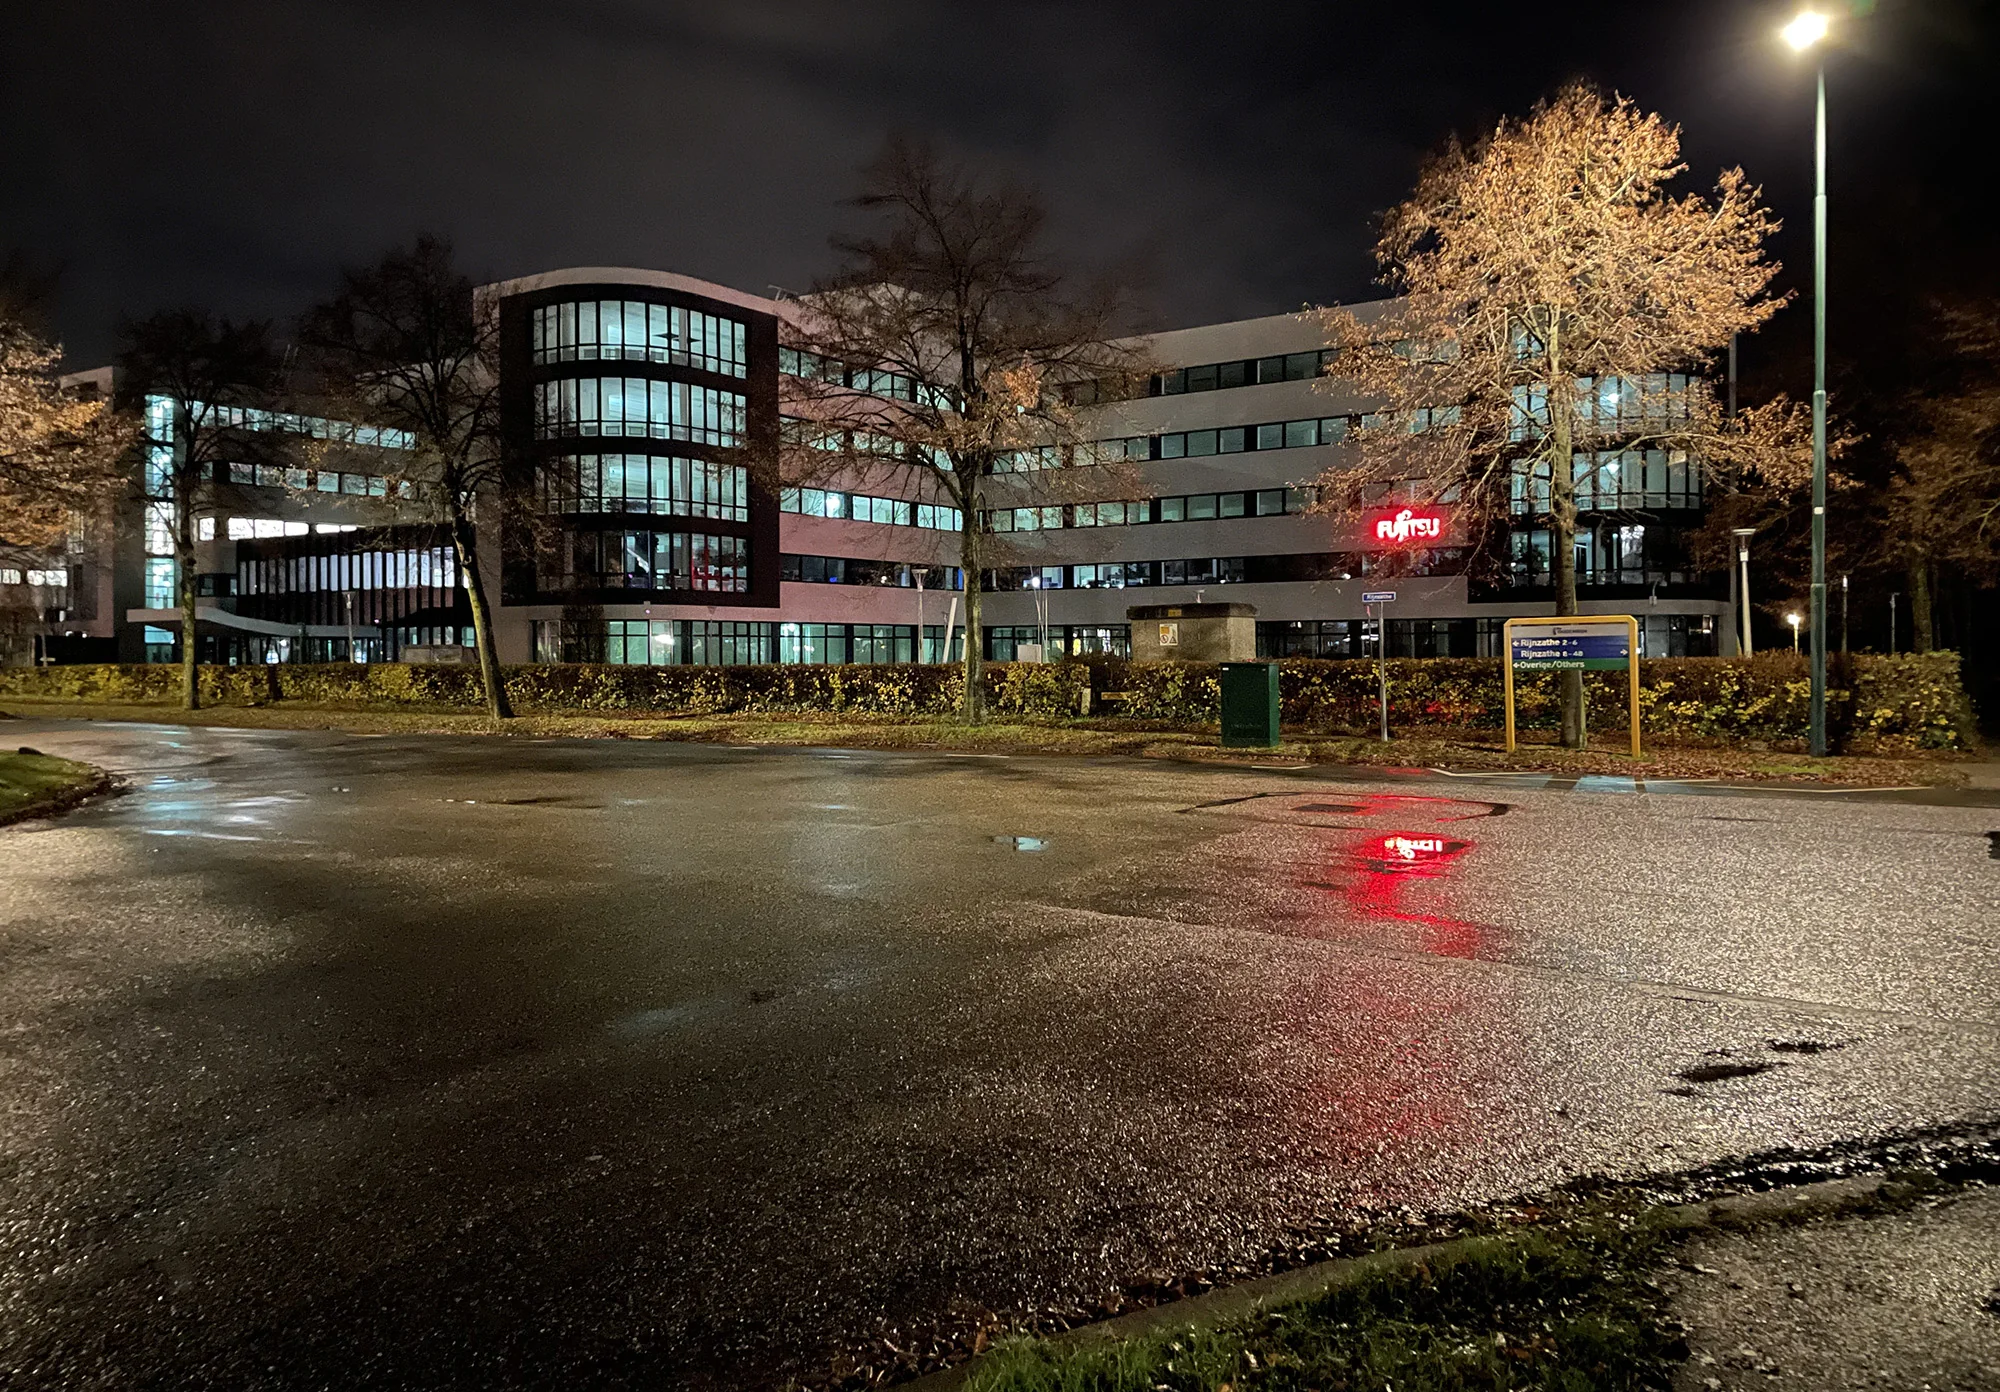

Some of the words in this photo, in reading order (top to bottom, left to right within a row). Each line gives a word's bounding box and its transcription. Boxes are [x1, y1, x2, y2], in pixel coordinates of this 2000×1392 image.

[1377, 510, 1440, 542] FUJITSU
[1520, 639, 1561, 648] Rijnzathe
[1521, 650, 1561, 659] Rijnzathe
[1520, 661, 1585, 669] Overige/Others
